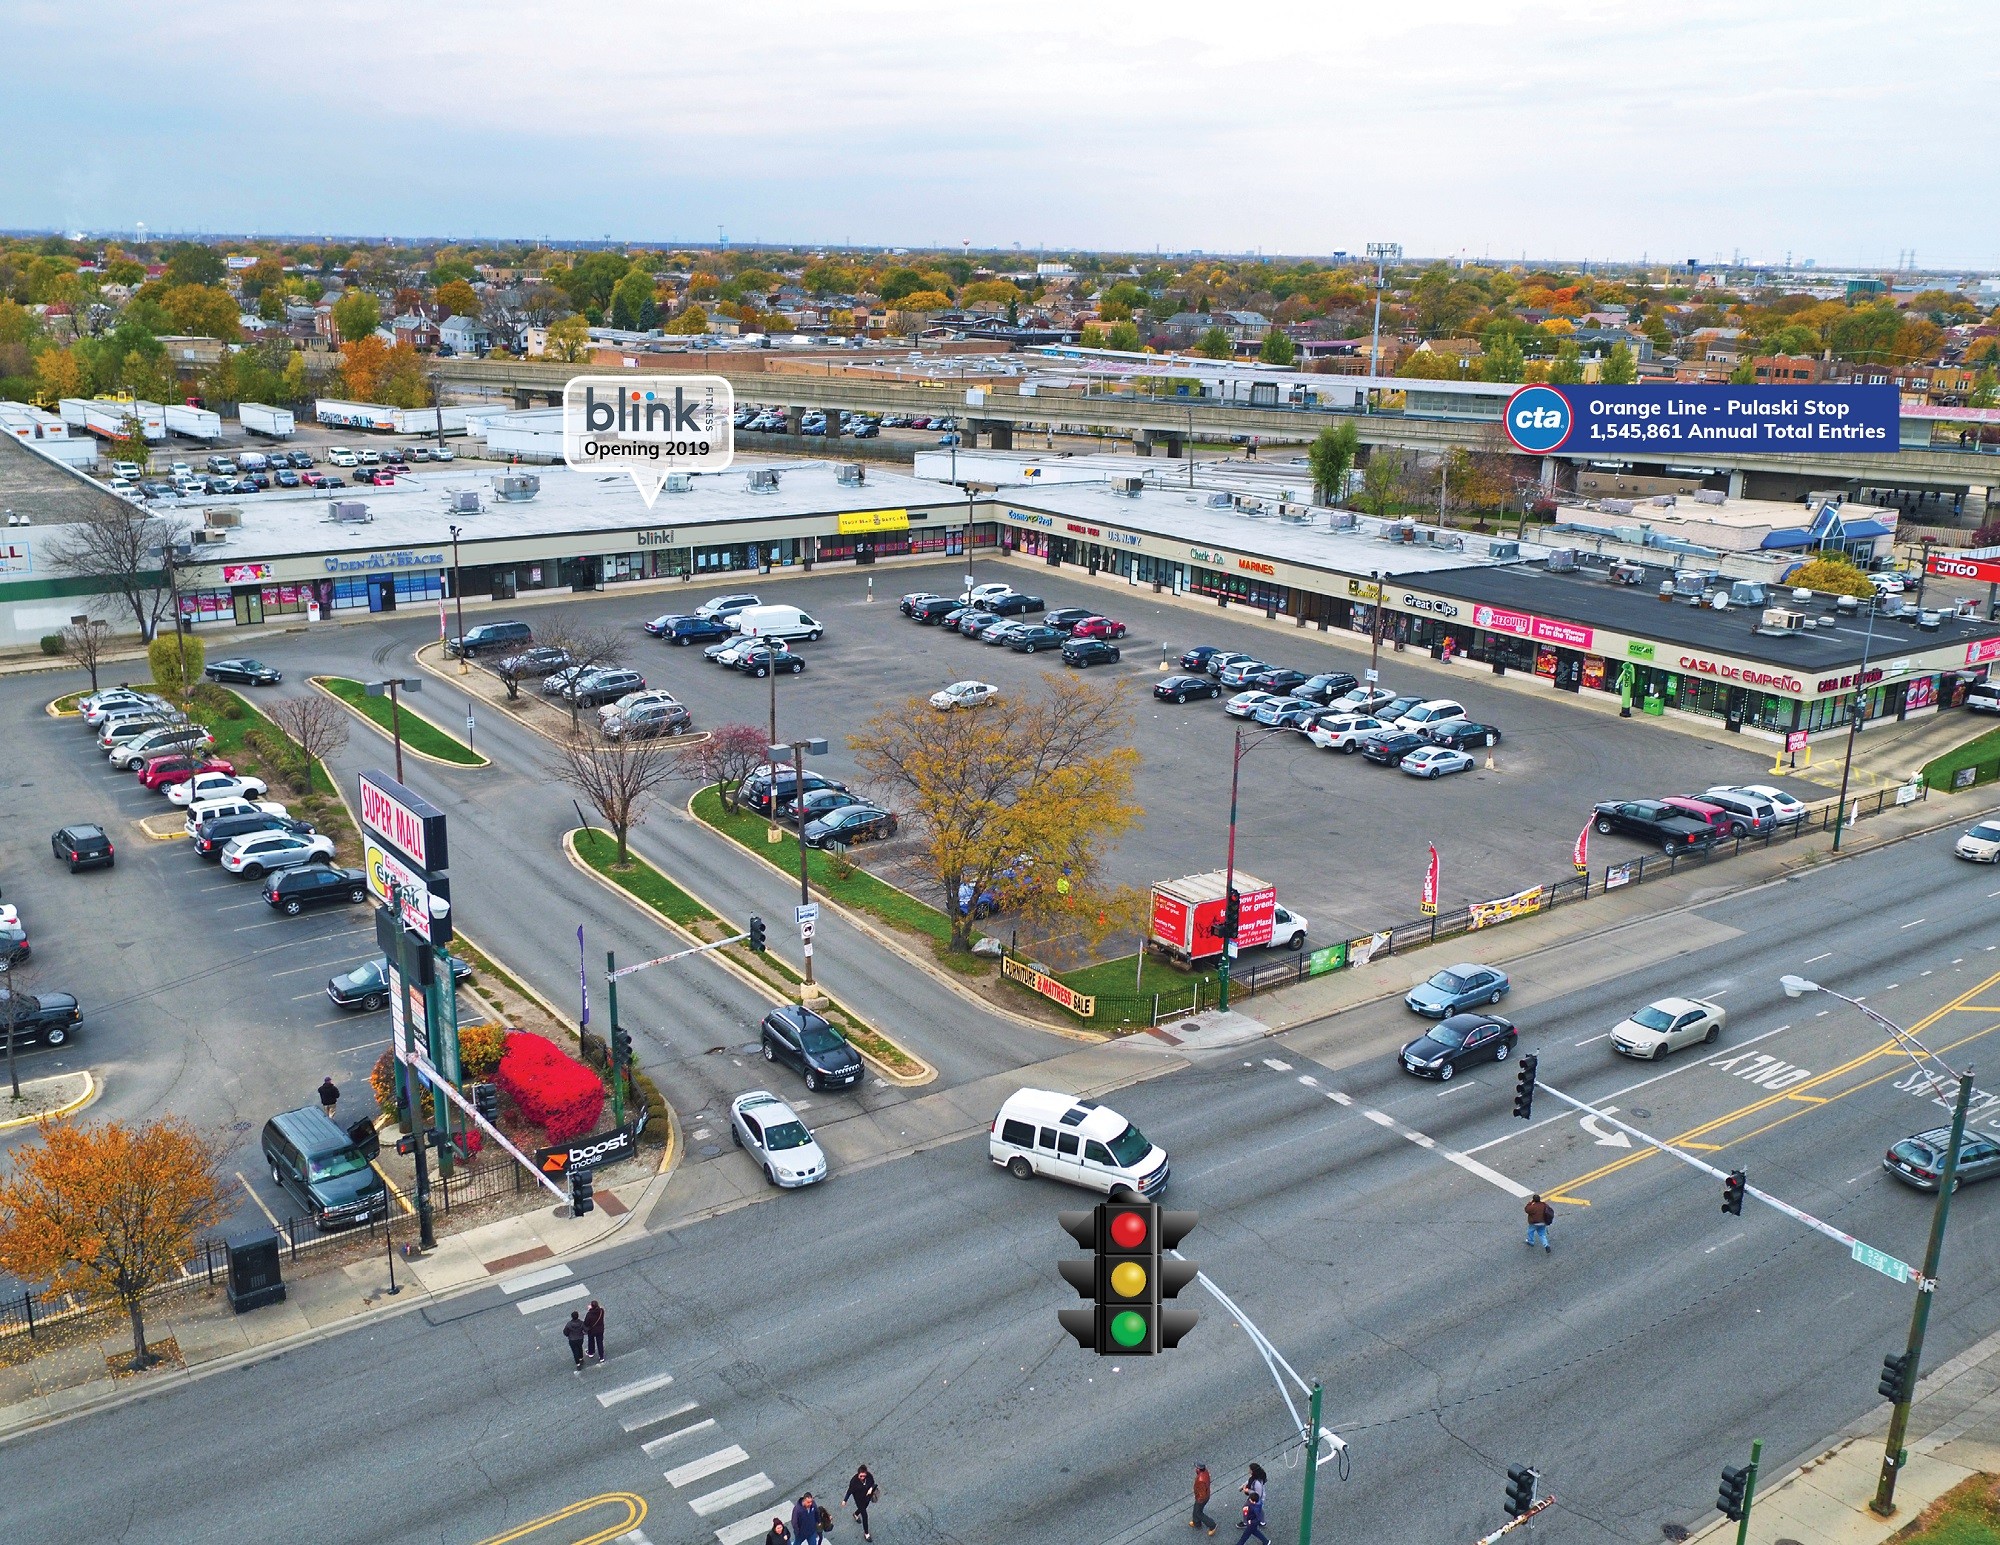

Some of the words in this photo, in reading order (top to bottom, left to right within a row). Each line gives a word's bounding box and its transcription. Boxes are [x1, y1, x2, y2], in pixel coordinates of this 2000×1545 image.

[637, 530, 671, 546] blink
[1121, 533, 1142, 547] NAVY
[340, 558, 388, 571] DENTAL
[396, 553, 444, 567] BRACES
[1238, 559, 1275, 576] MARINES
[1936, 560, 1978, 577] CITGO
[1403, 594, 1431, 610] Great
[1433, 601, 1457, 616] Clips
[1679, 656, 1718, 675] CASA
[1721, 664, 1740, 679] DE
[1742, 669, 1802, 693] EMPEÑO
[1818, 678, 1839, 693] CASA
[1840, 675, 1853, 689] DE
[1789, 740, 1806, 750] OPEN
[1790, 732, 1805, 742] NOW
[362, 783, 394, 838] SUPER
[395, 806, 424, 861] MALL
[1254, 892, 1274, 903] place
[1256, 919, 1272, 928] Plaza
[1005, 959, 1036, 988] FURNITURE
[1037, 975, 1043, 991] &
[1042, 978, 1072, 1006] MATTRESS
[1073, 995, 1090, 1014] SALE
[1708, 1050, 1812, 1090] ONLY
[569, 1132, 628, 1163] boost
[570, 1154, 602, 1170] mobile
